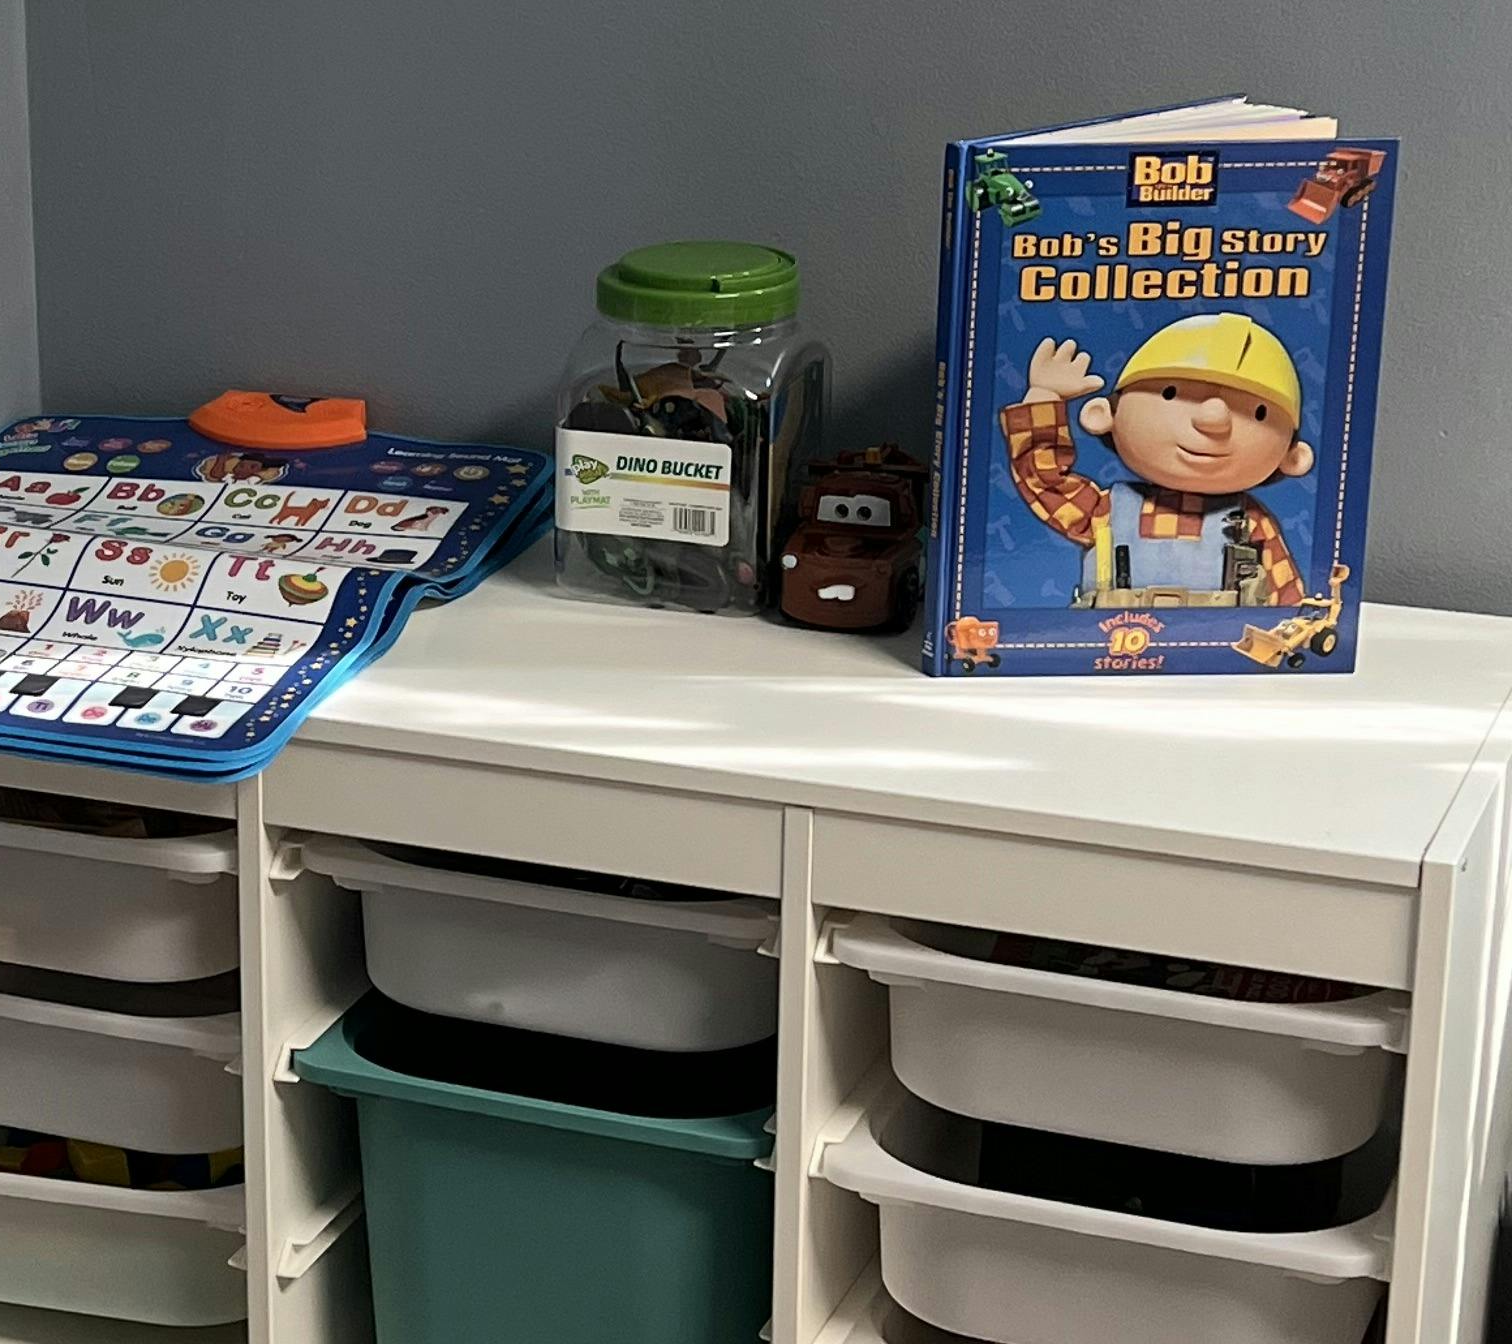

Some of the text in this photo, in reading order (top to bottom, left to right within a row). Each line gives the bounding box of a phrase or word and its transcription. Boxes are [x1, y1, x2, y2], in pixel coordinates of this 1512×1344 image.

[1134, 154, 1214, 185] Bob
[1138, 184, 1214, 203] Builder
[1013, 221, 1328, 261] Bob's Big Story
[1019, 261, 1311, 302] Collection
[616, 455, 723, 480] DINO BUCKET
[107, 482, 166, 502] Bb
[224, 488, 281, 509] Cc
[344, 495, 409, 518] Dd
[95, 539, 154, 565] Ss
[314, 536, 377, 555] Hh
[227, 555, 277, 581] Tt
[101, 575, 125, 587] Sun
[226, 590, 248, 605] Toy
[65, 596, 146, 630] Ww
[1097, 611, 1166, 634] Includes
[189, 614, 254, 645] Xx
[1109, 626, 1150, 656] 10
[1094, 655, 1165, 670] stories!
